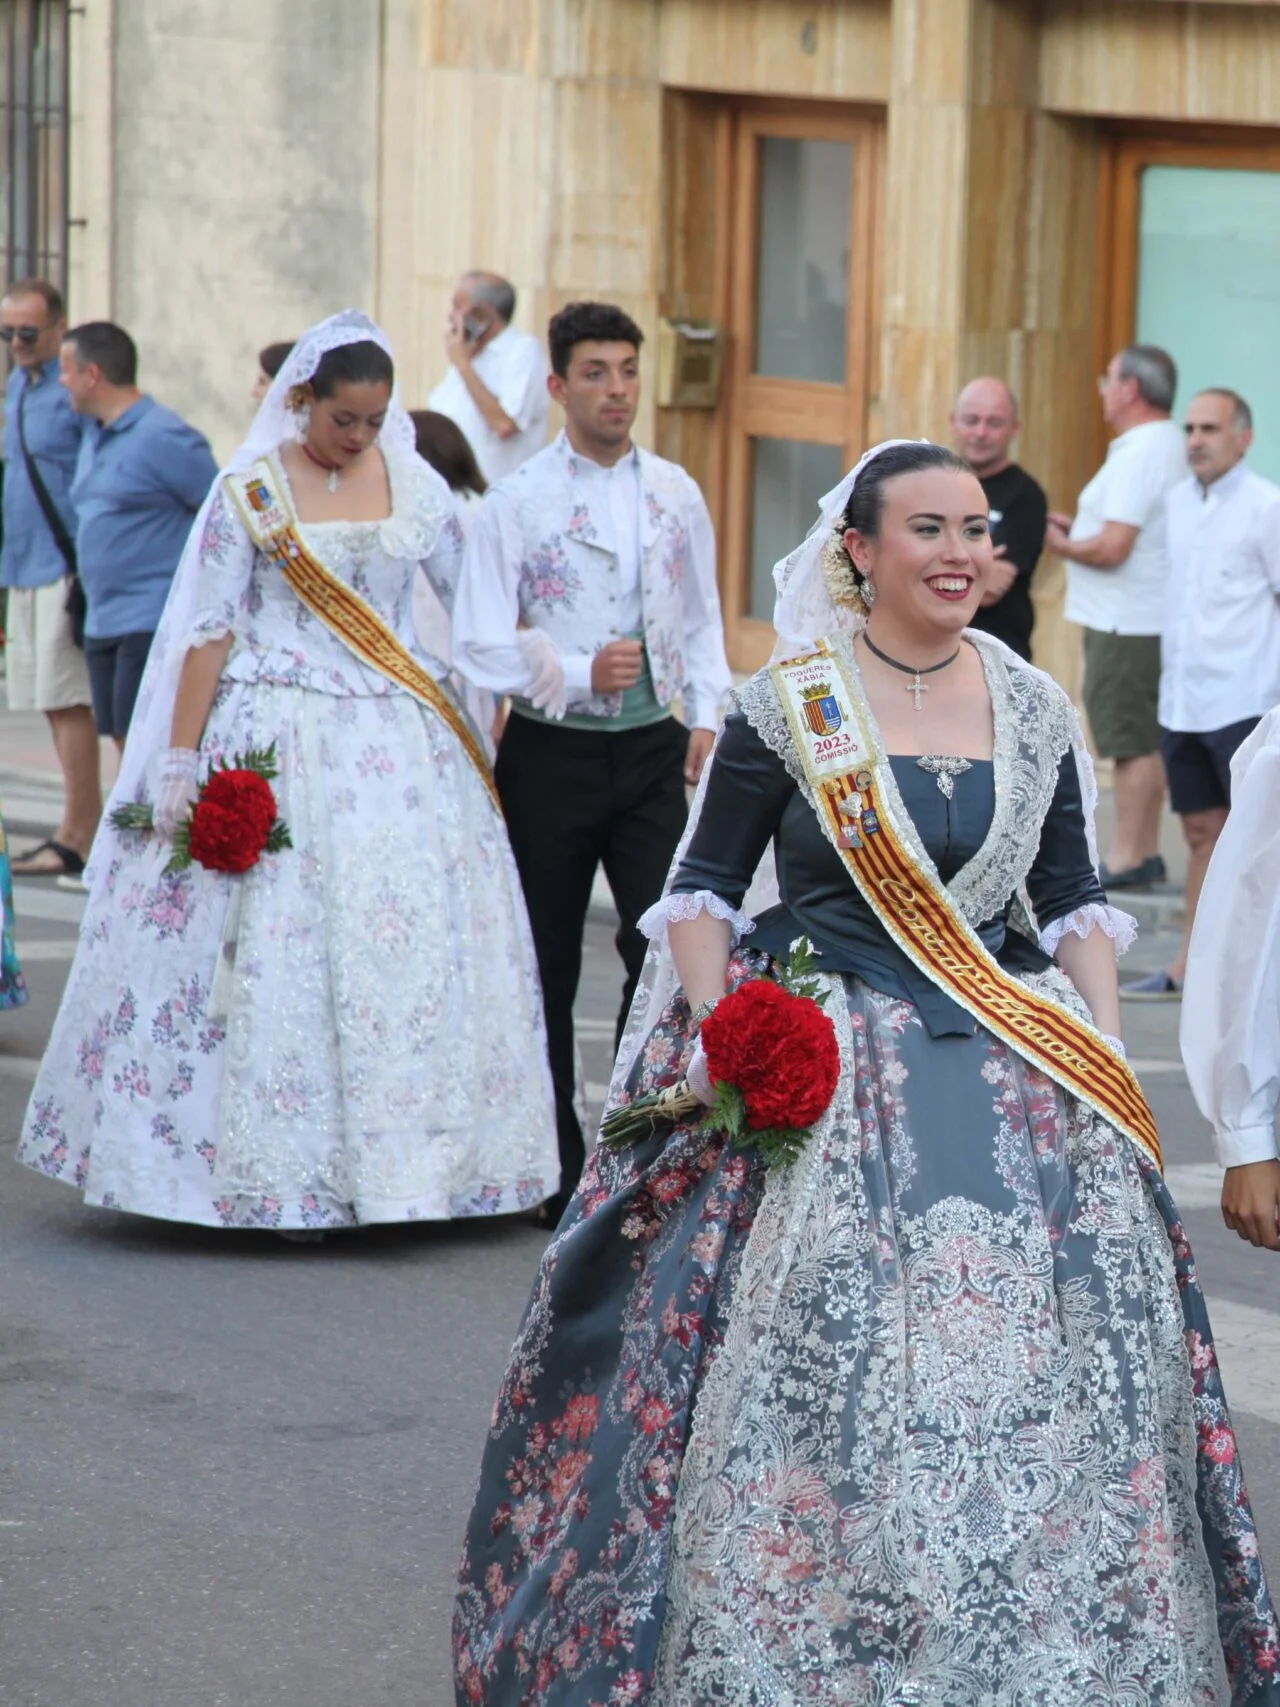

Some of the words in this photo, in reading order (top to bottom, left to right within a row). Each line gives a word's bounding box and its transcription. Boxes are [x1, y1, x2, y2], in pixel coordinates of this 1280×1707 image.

[783, 664, 832, 679] FOGUERES
[813, 733, 851, 754] 2023
[879, 878, 944, 952] Cort
